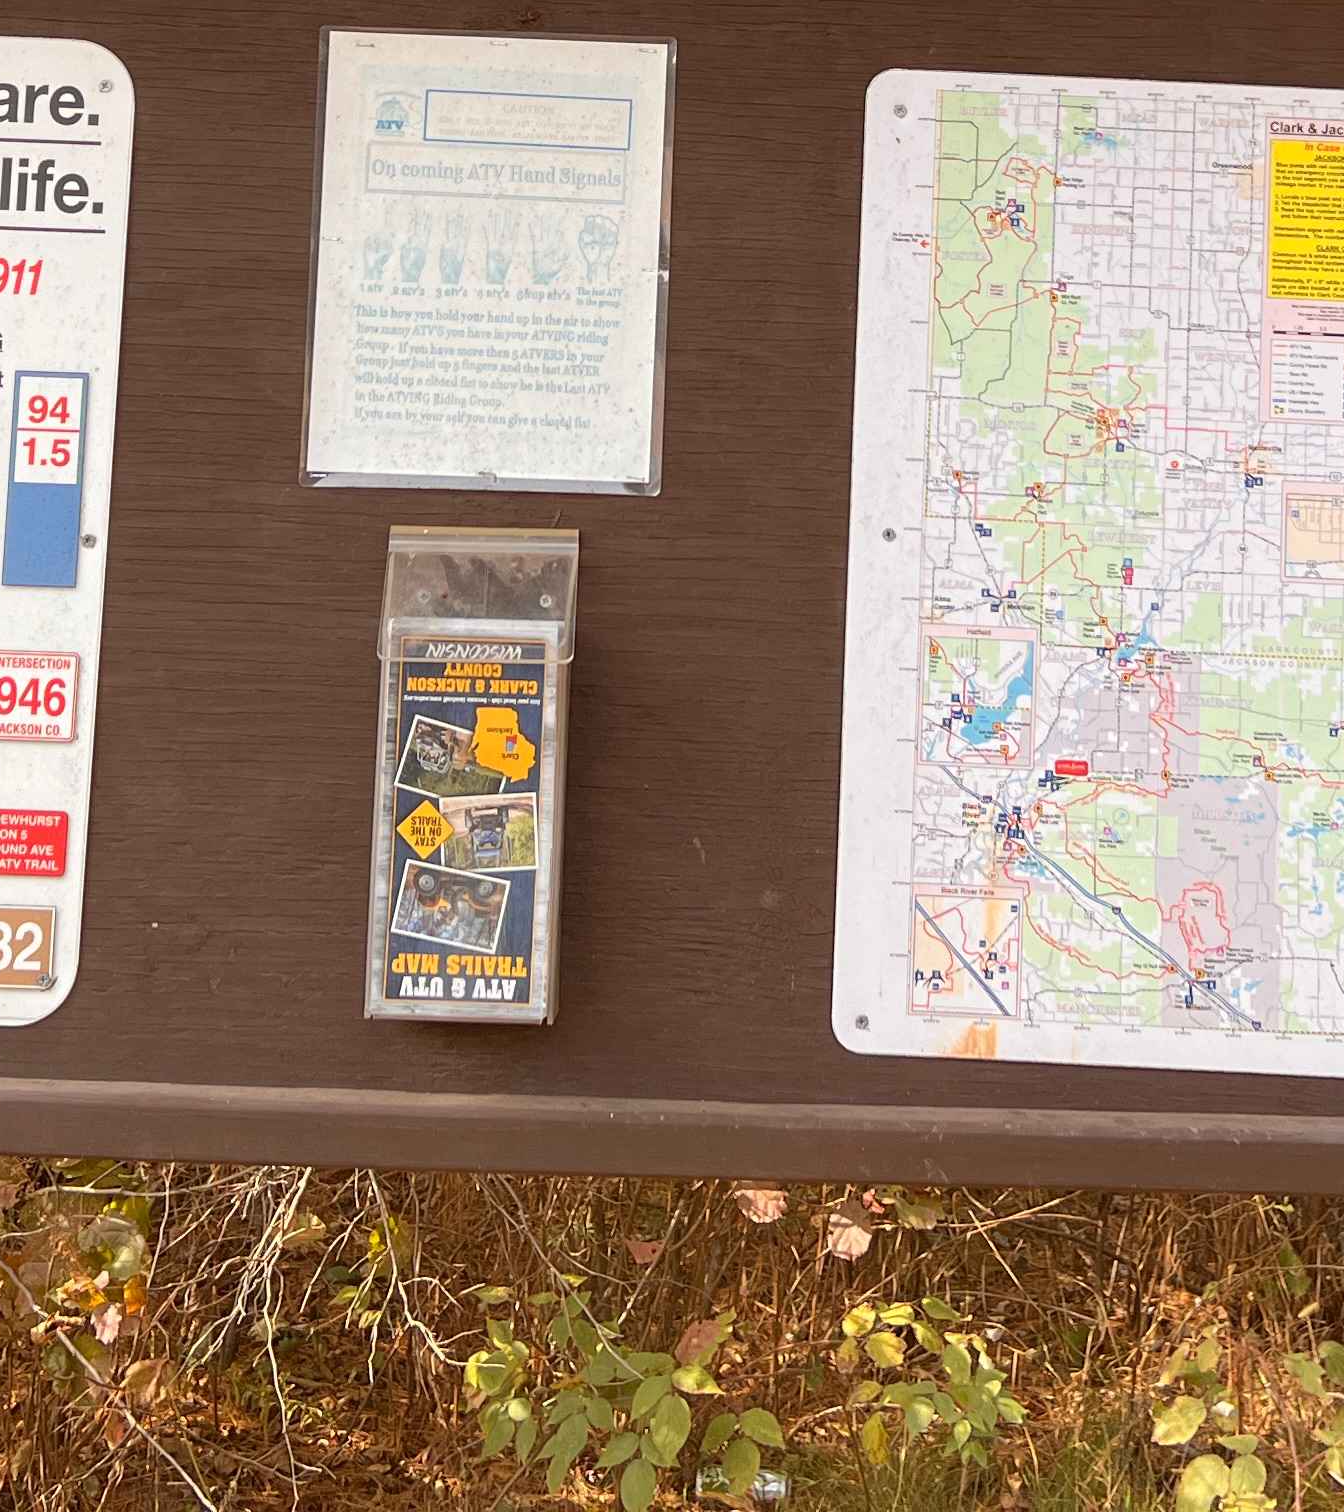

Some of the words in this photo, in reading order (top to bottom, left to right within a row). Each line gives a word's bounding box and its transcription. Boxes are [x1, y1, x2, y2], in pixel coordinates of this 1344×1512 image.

[1270, 121, 1303, 134] Clark
[1308, 123, 1318, 134] &
[371, 159, 396, 179] On
[401, 161, 465, 185] coming
[467, 163, 505, 182] ATV
[510, 164, 555, 185] Hand
[559, 167, 622, 190] Signals
[0, 157, 104, 214] life.
[27, 394, 70, 424] 94
[25, 437, 71, 467] 1.5
[425, 643, 522, 661] WISCONSIN
[444, 662, 502, 677] COUNTY
[406, 676, 472, 693] JACKSON
[475, 678, 486, 693] &
[489, 679, 538, 695] CLARK
[45, 724, 63, 736] CO.
[410, 816, 442, 826] TRAILS
[410, 826, 427, 836] THE
[428, 827, 442, 836] ON
[29, 844, 53, 856] AVE
[414, 837, 436, 847] STAY
[24, 859, 58, 871] TRAIL
[391, 952, 440, 975] MAP
[446, 954, 528, 977] TRAILS
[399, 975, 444, 998] UTV
[451, 977, 466, 999] &
[472, 978, 517, 1001] ATV
